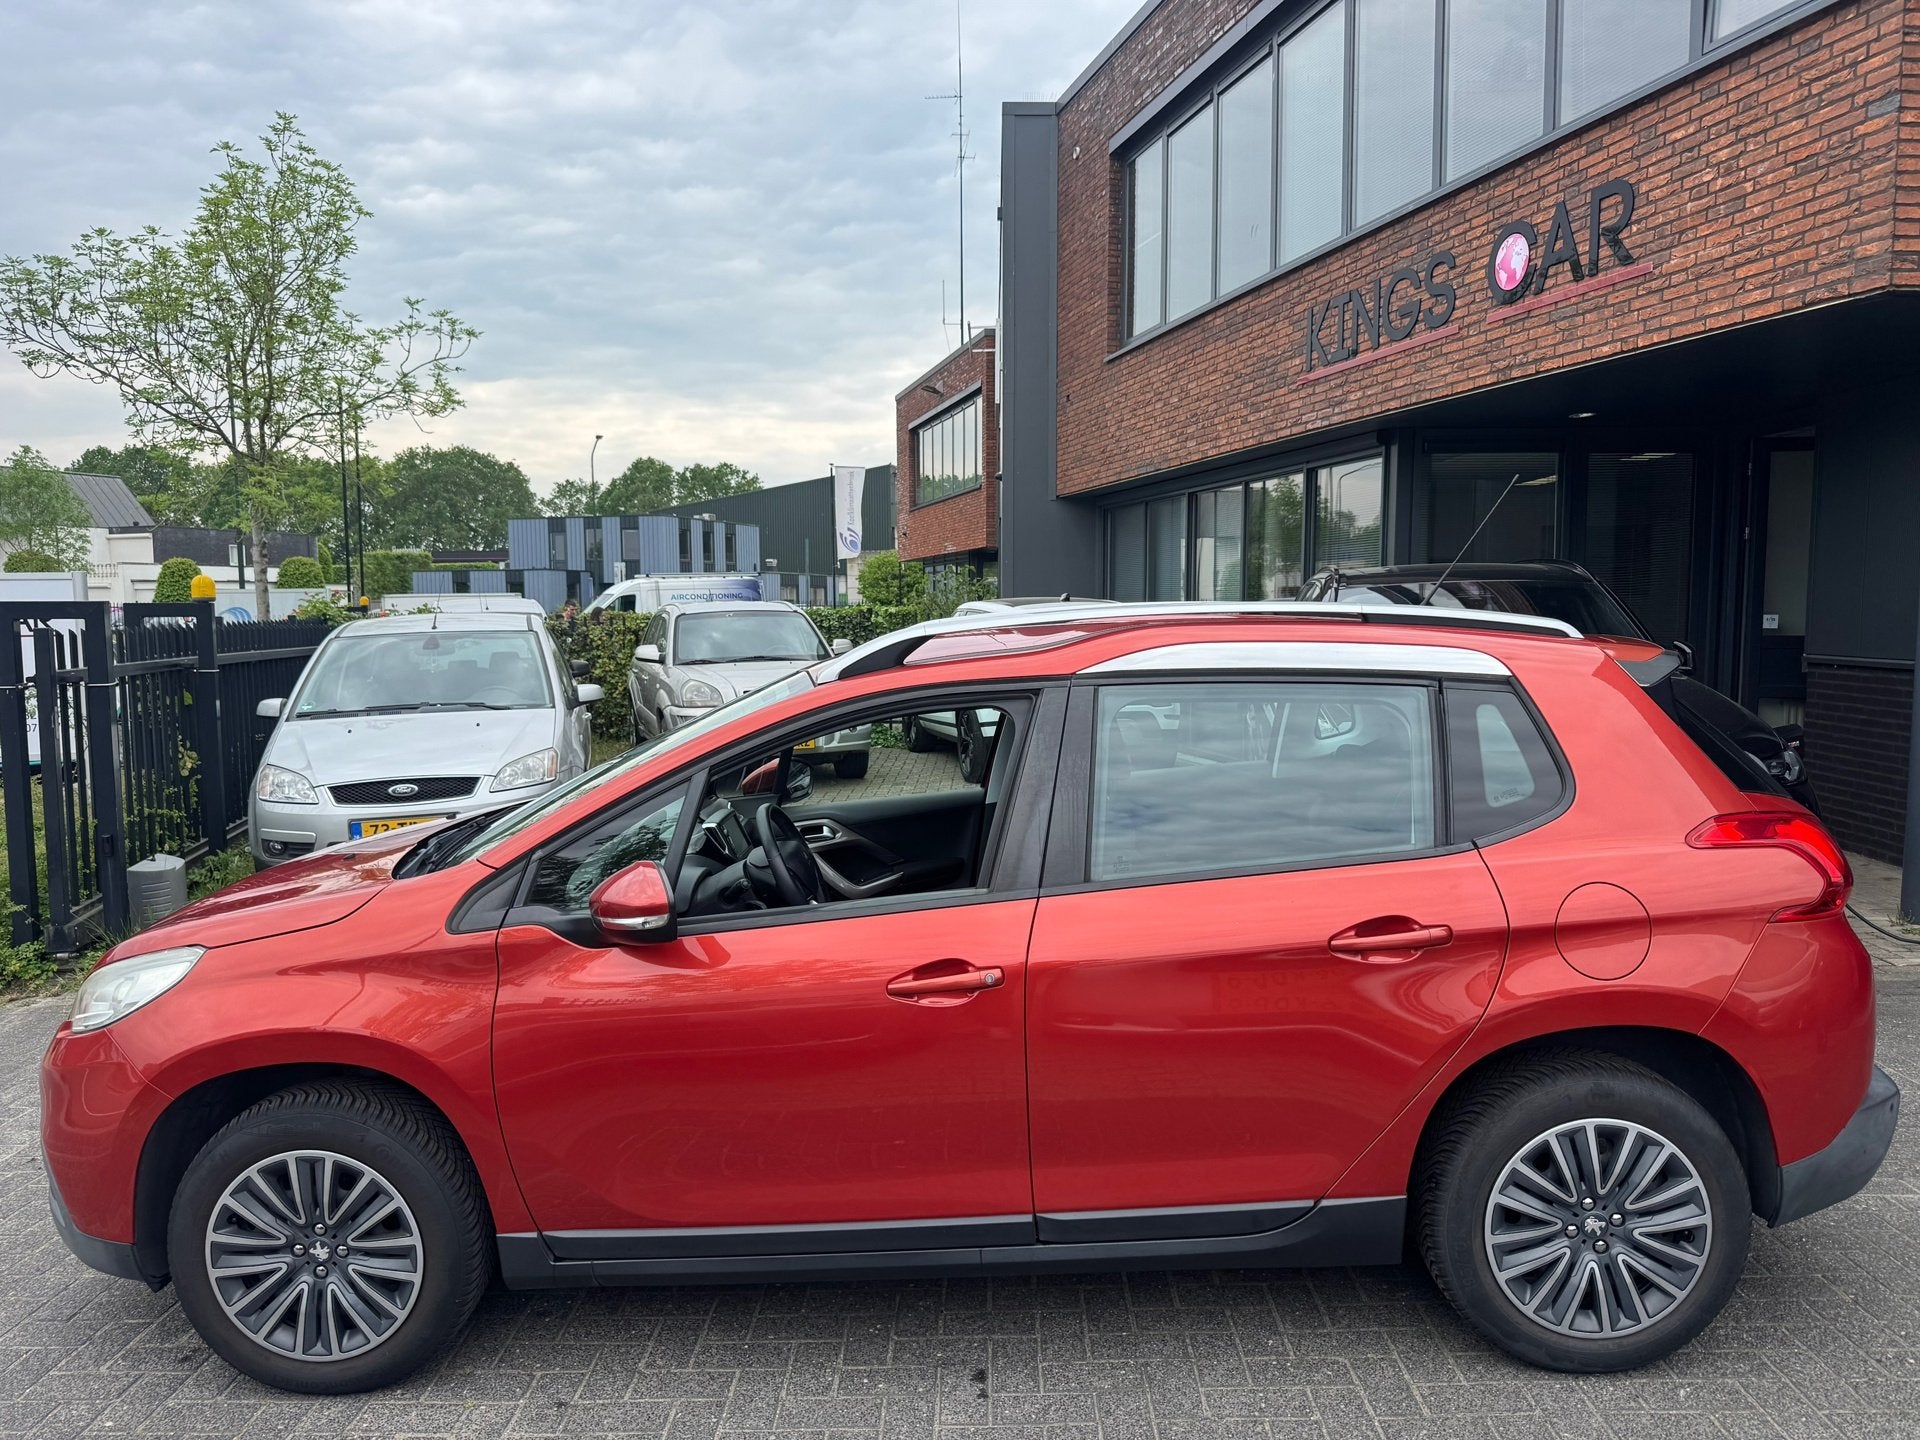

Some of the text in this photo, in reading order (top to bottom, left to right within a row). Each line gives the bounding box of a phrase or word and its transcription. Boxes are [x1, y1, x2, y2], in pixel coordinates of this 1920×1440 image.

[1304, 178, 1636, 371] KINGS CAR
[671, 592, 744, 601] AIRCONDITIONING
